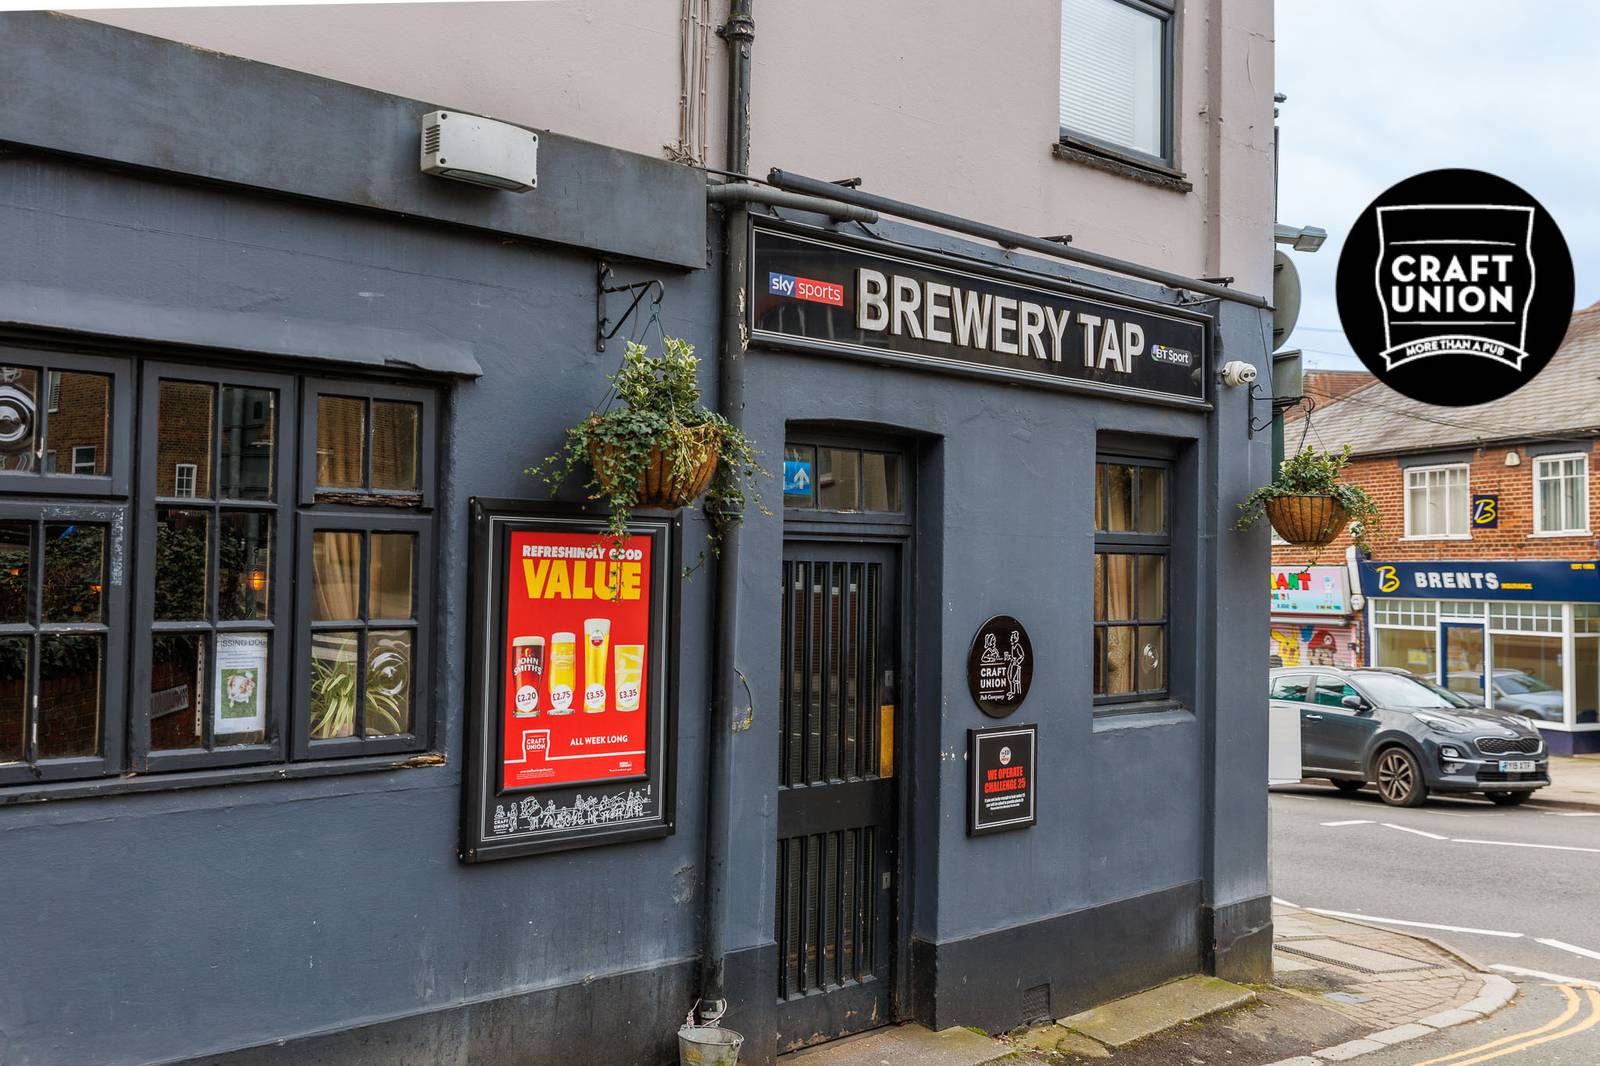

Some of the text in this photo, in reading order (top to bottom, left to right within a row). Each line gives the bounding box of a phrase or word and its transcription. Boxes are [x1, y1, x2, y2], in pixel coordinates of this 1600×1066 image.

[771, 275, 841, 301] sky sports
[856, 267, 1145, 374] BREWERY TAP
[1156, 348, 1189, 364] BT Sport
[522, 545, 643, 561] REFRESHINGLY GOOD
[522, 558, 642, 601] VALUE
[1414, 572, 1500, 590] BRENTS
[980, 667, 1007, 678] CRAFT
[980, 678, 1007, 689] UNION
[517, 691, 537, 703] £2.20
[552, 690, 571, 701] £2.75
[586, 690, 605, 700] £3.55
[619, 688, 638, 699] £3.35
[570, 734, 628, 746] ALL WEEK LONG
[526, 743, 546, 751] UNION
[987, 765, 1024, 780] WE OPERATE
[984, 779, 1017, 794] CHALLENGE
